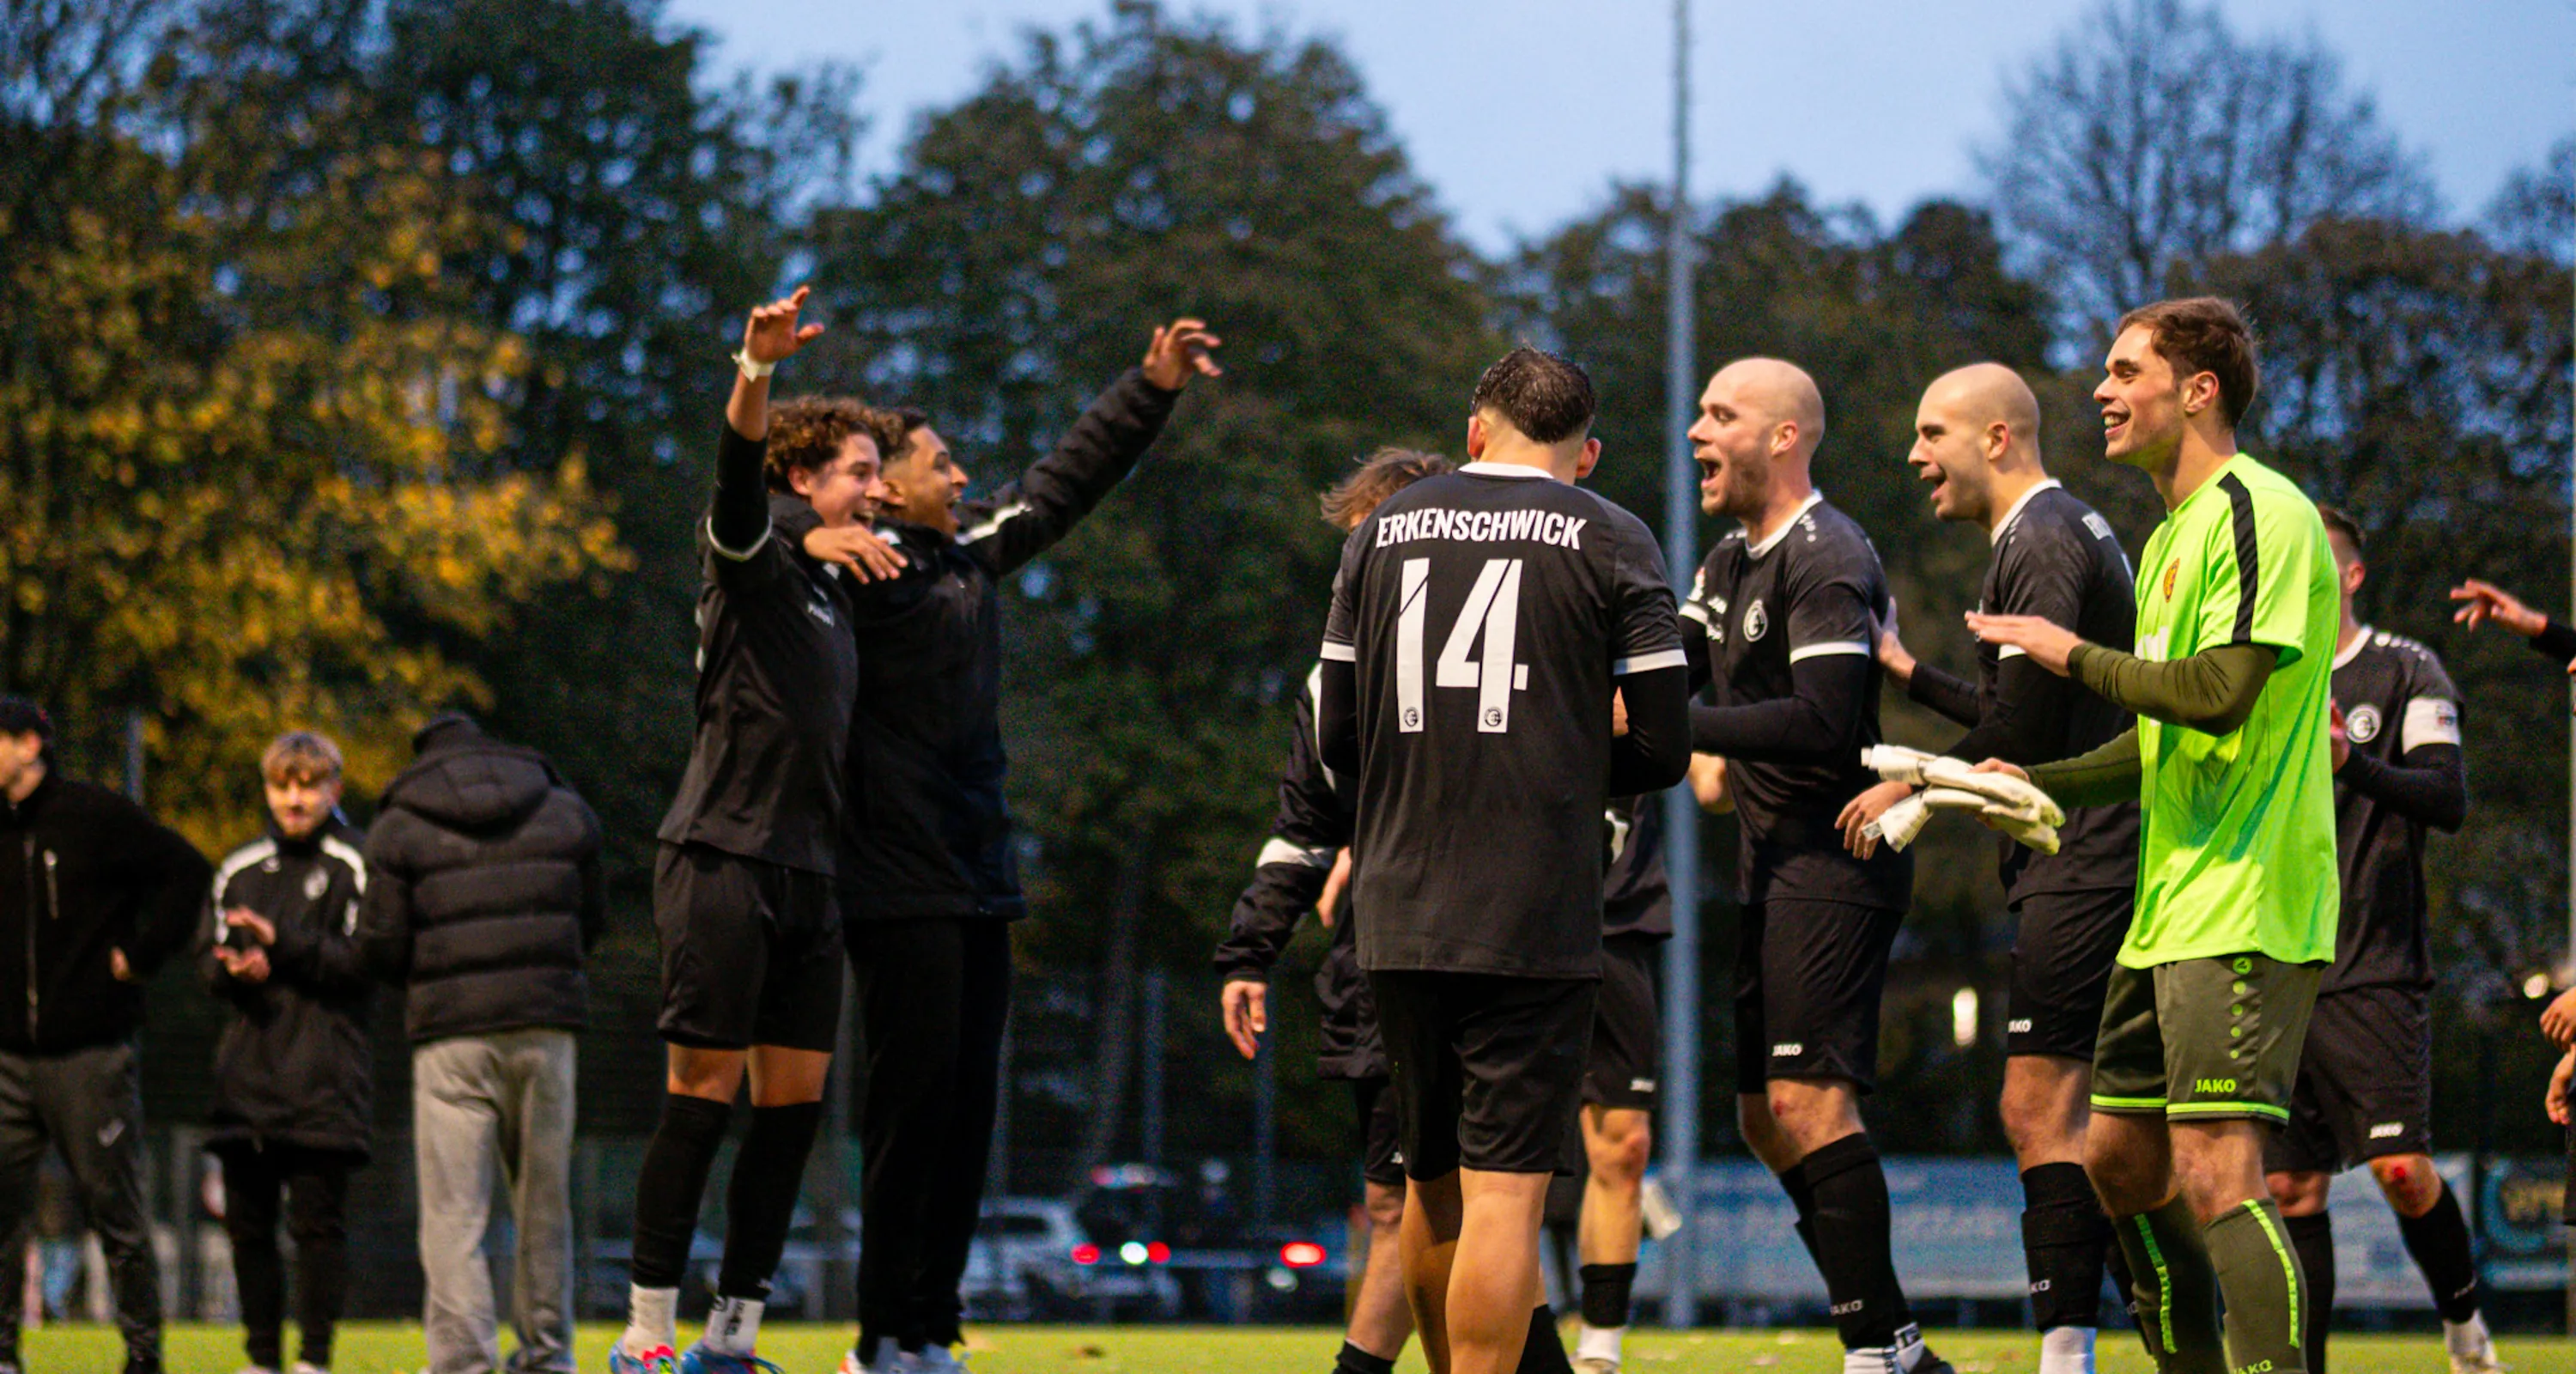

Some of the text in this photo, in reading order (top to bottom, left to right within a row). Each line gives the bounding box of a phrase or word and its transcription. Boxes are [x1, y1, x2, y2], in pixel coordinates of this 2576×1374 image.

[1376, 508, 1587, 550] ERKENSCHWICK
[1396, 557, 1528, 733] 14
[2008, 1019, 2032, 1033] AKO
[1772, 1043, 1802, 1056] JAKO
[2194, 1079, 2236, 1093] JAKO
